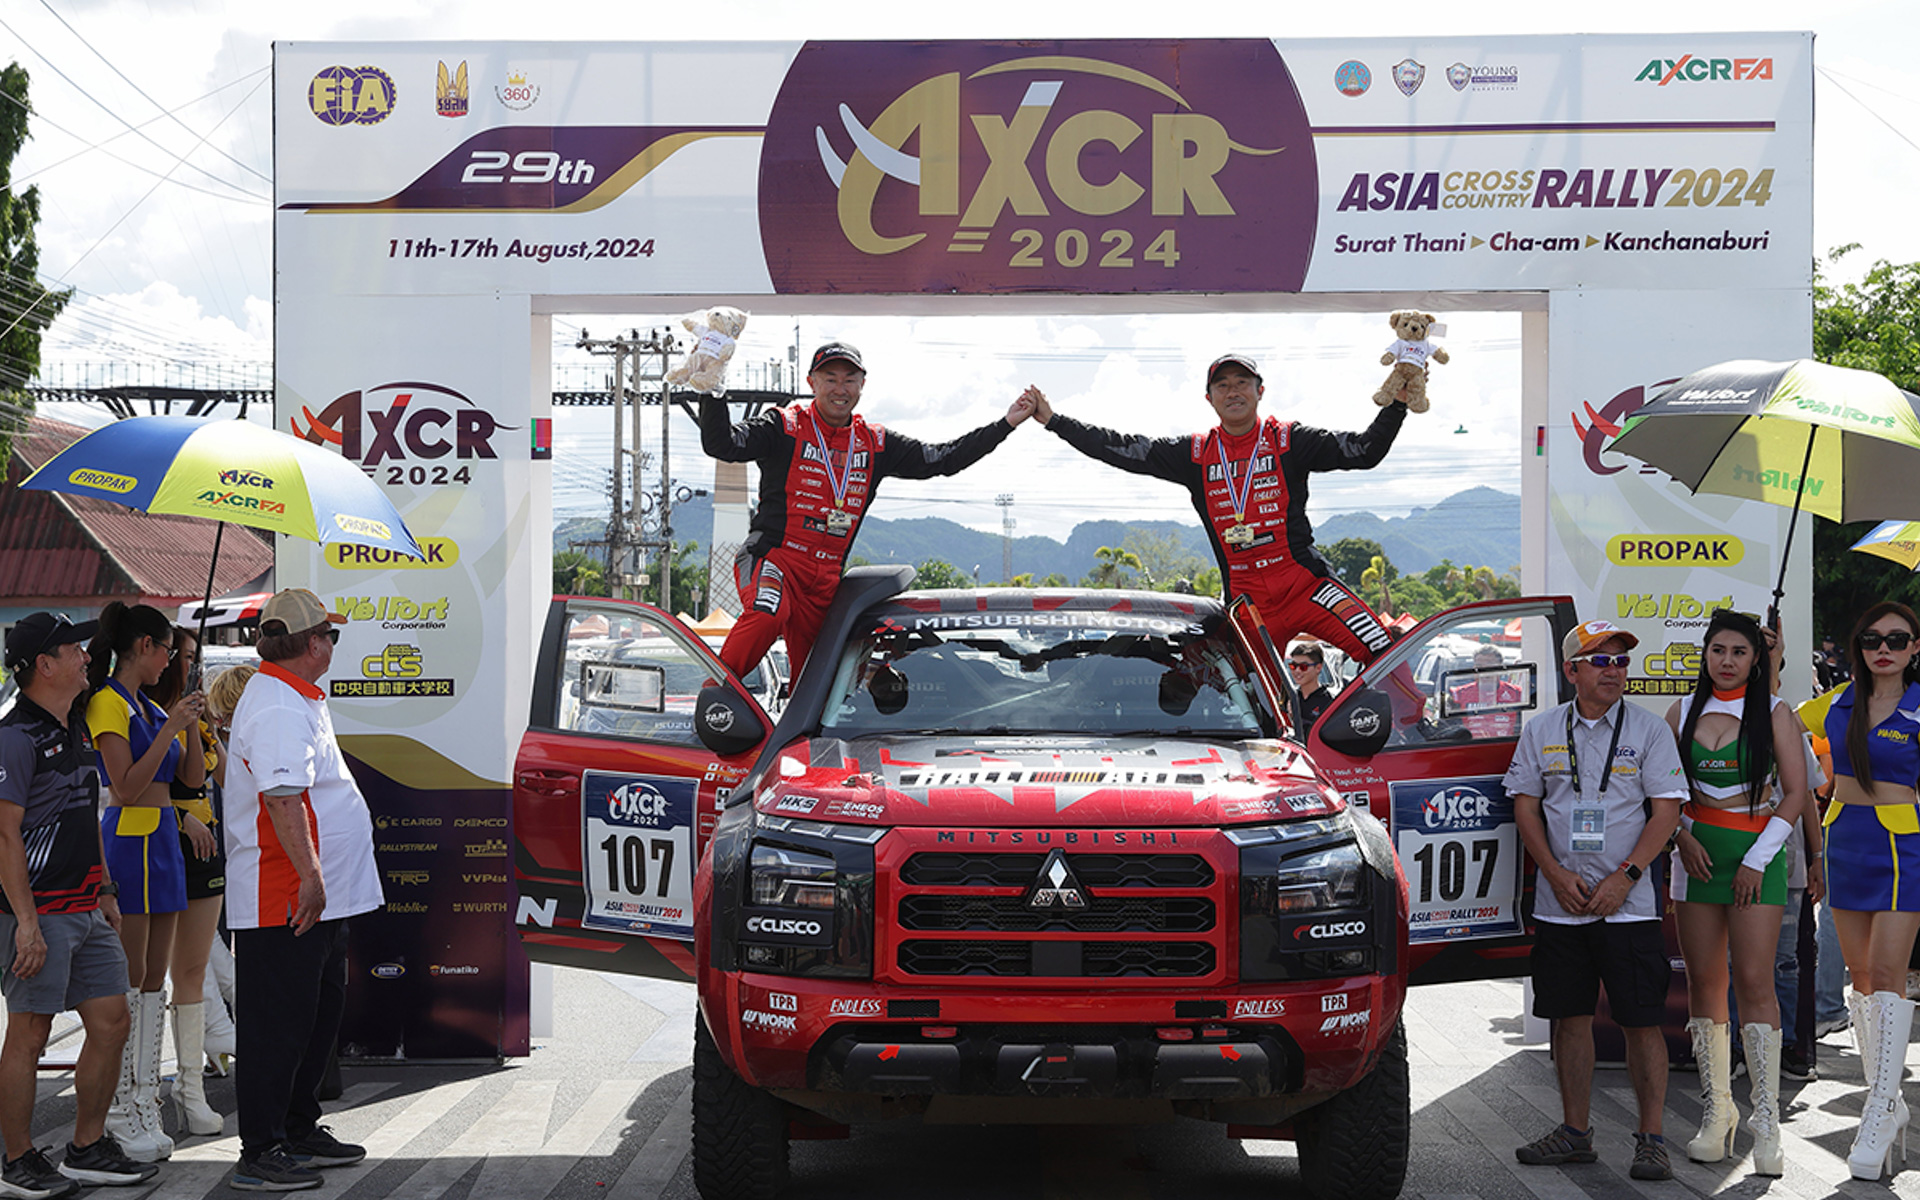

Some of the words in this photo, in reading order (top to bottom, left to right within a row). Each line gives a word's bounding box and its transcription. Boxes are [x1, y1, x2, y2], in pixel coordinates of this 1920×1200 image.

[1473, 66, 1518, 76] YOUNG
[1634, 54, 1774, 86] AXCRFA
[461, 150, 596, 184] 29th
[837, 70, 1238, 255] AXCR
[1442, 170, 1535, 192] CROSS
[1531, 168, 1673, 209] RALLY
[1663, 167, 1776, 208] 2024
[1336, 171, 1441, 212] ASIA
[1442, 193, 1531, 210] COUNTRY
[388, 238, 499, 259] 11th-17th
[504, 237, 656, 263] August,2024
[1008, 229, 1181, 268] 2024
[1334, 233, 1397, 254] Surat
[1402, 232, 1466, 253] Thani
[1489, 232, 1581, 252] Cha-am
[1603, 230, 1771, 252] Kanchanaburi
[74, 469, 131, 491] PROPAK
[219, 469, 275, 489] AXCR
[386, 466, 472, 486] 2024
[197, 490, 286, 514] AXCRFA
[1620, 540, 1730, 561] PROPAK
[381, 621, 447, 631] Corporation
[915, 614, 1086, 631] MITSUBISHI
[1088, 615, 1205, 636] MOTORS
[333, 681, 451, 696] 中央自動車大学校
[608, 784, 667, 820] AXCR
[779, 796, 816, 809] HKS
[843, 802, 885, 814] ENEOS
[1286, 796, 1323, 809] HKS
[1424, 790, 1491, 828] AXCR
[401, 818, 443, 827] CARGO
[633, 815, 659, 826] 2024
[1453, 818, 1482, 829] 2024
[937, 831, 1178, 845] MITSUBISHI
[601, 833, 675, 898] 107
[1413, 839, 1499, 903] 107
[604, 900, 624, 911] ASIA
[638, 903, 664, 916] RALLY
[662, 907, 683, 919] 2024
[1411, 911, 1432, 924] ASIA
[1449, 907, 1478, 920] RALLY
[1477, 906, 1500, 918] 2024
[1309, 921, 1367, 938] CUSCO
[440, 965, 479, 975] funatiko
[771, 994, 796, 1010] TPR
[829, 998, 882, 1014] ENDLESS
[1234, 999, 1286, 1015] ENDLESS
[1323, 994, 1346, 1011] TPR
[758, 1011, 797, 1031] WORK
[1339, 1009, 1371, 1028] WORK
